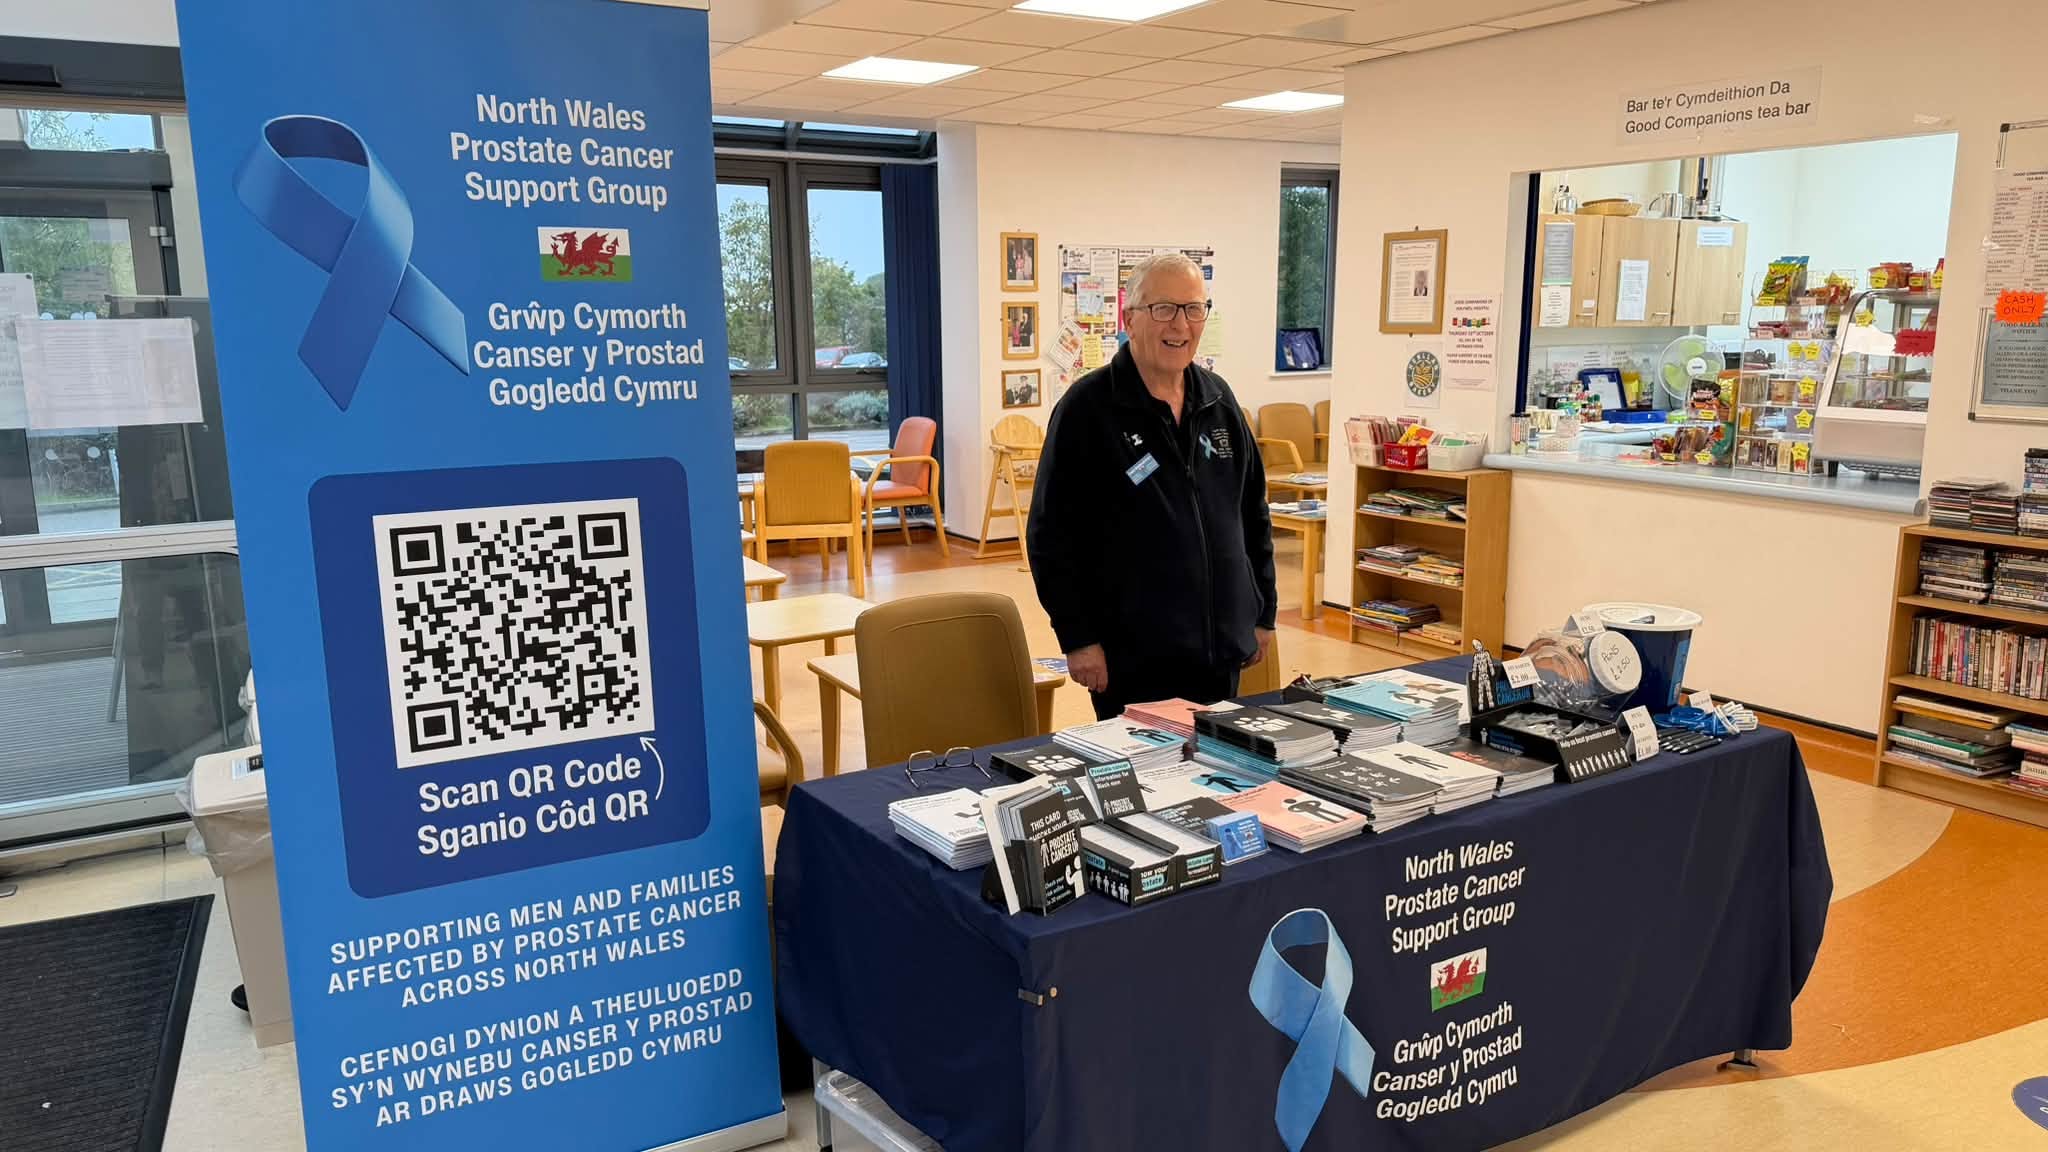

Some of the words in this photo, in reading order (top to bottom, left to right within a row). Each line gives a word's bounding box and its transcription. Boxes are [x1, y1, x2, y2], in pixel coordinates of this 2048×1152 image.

[476, 94, 557, 125] North
[564, 99, 646, 131] Wales
[1626, 118, 1661, 134] Good
[1665, 108, 1753, 129] Companions
[1758, 105, 1780, 119] tea
[1785, 101, 1811, 116] bar
[1627, 100, 1648, 113] Bar
[1652, 96, 1672, 110] te'r
[1676, 85, 1765, 110] Cymdeithion
[1770, 80, 1790, 95] Da
[450, 132, 572, 165] Prostate
[580, 138, 674, 169] Cancer
[465, 171, 580, 207] Support
[587, 176, 668, 212] Group
[488, 301, 565, 336] Grŵp
[573, 302, 687, 335] Cymorth
[2003, 305, 2036, 315] ONLY
[2004, 295, 2035, 304] CASH
[474, 340, 573, 368] Canser
[583, 346, 597, 372] y
[606, 338, 704, 366] Prostad
[489, 376, 605, 411] Gogledd
[614, 375, 698, 407] Cymru
[1576, 736, 1585, 745] beat
[1602, 728, 1617, 737] cancer
[419, 778, 499, 813] Scan
[508, 764, 554, 798] QR
[564, 753, 641, 789] Code
[417, 812, 527, 858] Sganio
[536, 797, 595, 833] Côd
[605, 789, 649, 822] QR
[1030, 819, 1045, 832] THIS
[1045, 810, 1061, 824] CARD
[1048, 829, 1077, 849] PROSTATE
[1050, 843, 1072, 864] CANCER
[1405, 848, 1454, 883] North
[1459, 840, 1514, 870] Wales
[1385, 881, 1459, 921] Prostate
[1463, 866, 1526, 899] Cancer
[330, 912, 501, 966] SUPPORTING
[510, 899, 564, 929] MEN
[573, 888, 622, 916] AND
[630, 865, 735, 904] FAMILIES
[1391, 915, 1459, 954] Support
[1462, 901, 1516, 933] Group
[327, 946, 463, 995] AFFECTED
[472, 939, 504, 964] BY
[514, 912, 642, 956] PROSTATE
[650, 889, 741, 927] CANCER
[402, 966, 506, 1009] ACROSS
[514, 948, 597, 984] NORTH
[606, 929, 686, 963] WALES
[340, 1033, 456, 1079] CEFNOGI
[465, 1009, 560, 1050] DYNION
[569, 1004, 585, 1026] A
[591, 967, 743, 1020] THEULUOEDD
[403, 1049, 512, 1093] WYNEBU
[521, 1023, 617, 1065] CANSER
[626, 1017, 641, 1040] Y
[649, 990, 753, 1034] PROSTAD
[1393, 1032, 1443, 1064] Grŵp
[1445, 1001, 1513, 1047] Cymorth
[376, 1100, 410, 1128] AR
[420, 1076, 513, 1117] DRAWS
[521, 1047, 633, 1092] GOGLEDD
[642, 1024, 722, 1062] CYMRU
[1373, 1064, 1447, 1093] Canser
[1450, 1059, 1460, 1086] y
[1463, 1026, 1523, 1074] Prostad
[1376, 1088, 1462, 1123] Gogledd
[1467, 1064, 1518, 1105] Cymru
